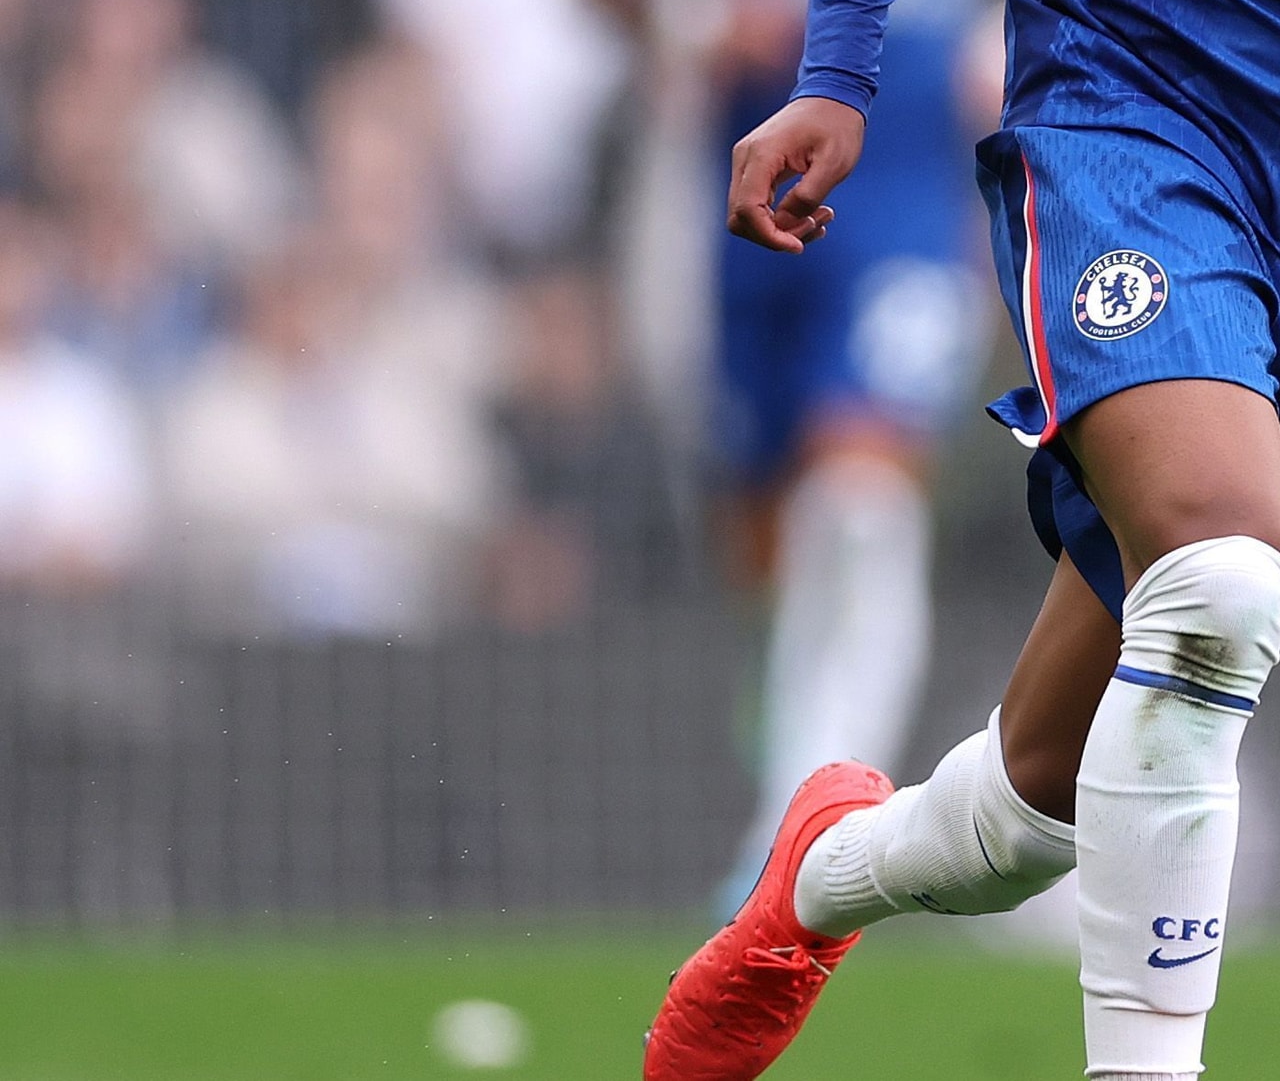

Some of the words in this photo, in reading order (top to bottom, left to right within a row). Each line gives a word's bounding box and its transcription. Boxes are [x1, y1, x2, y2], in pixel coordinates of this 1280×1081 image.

[1086, 253, 1147, 282] CHELSEA
[1088, 325, 1128, 336] FOOTBALL
[1130, 311, 1152, 328] CLUB
[1152, 916, 1220, 941] CFC
